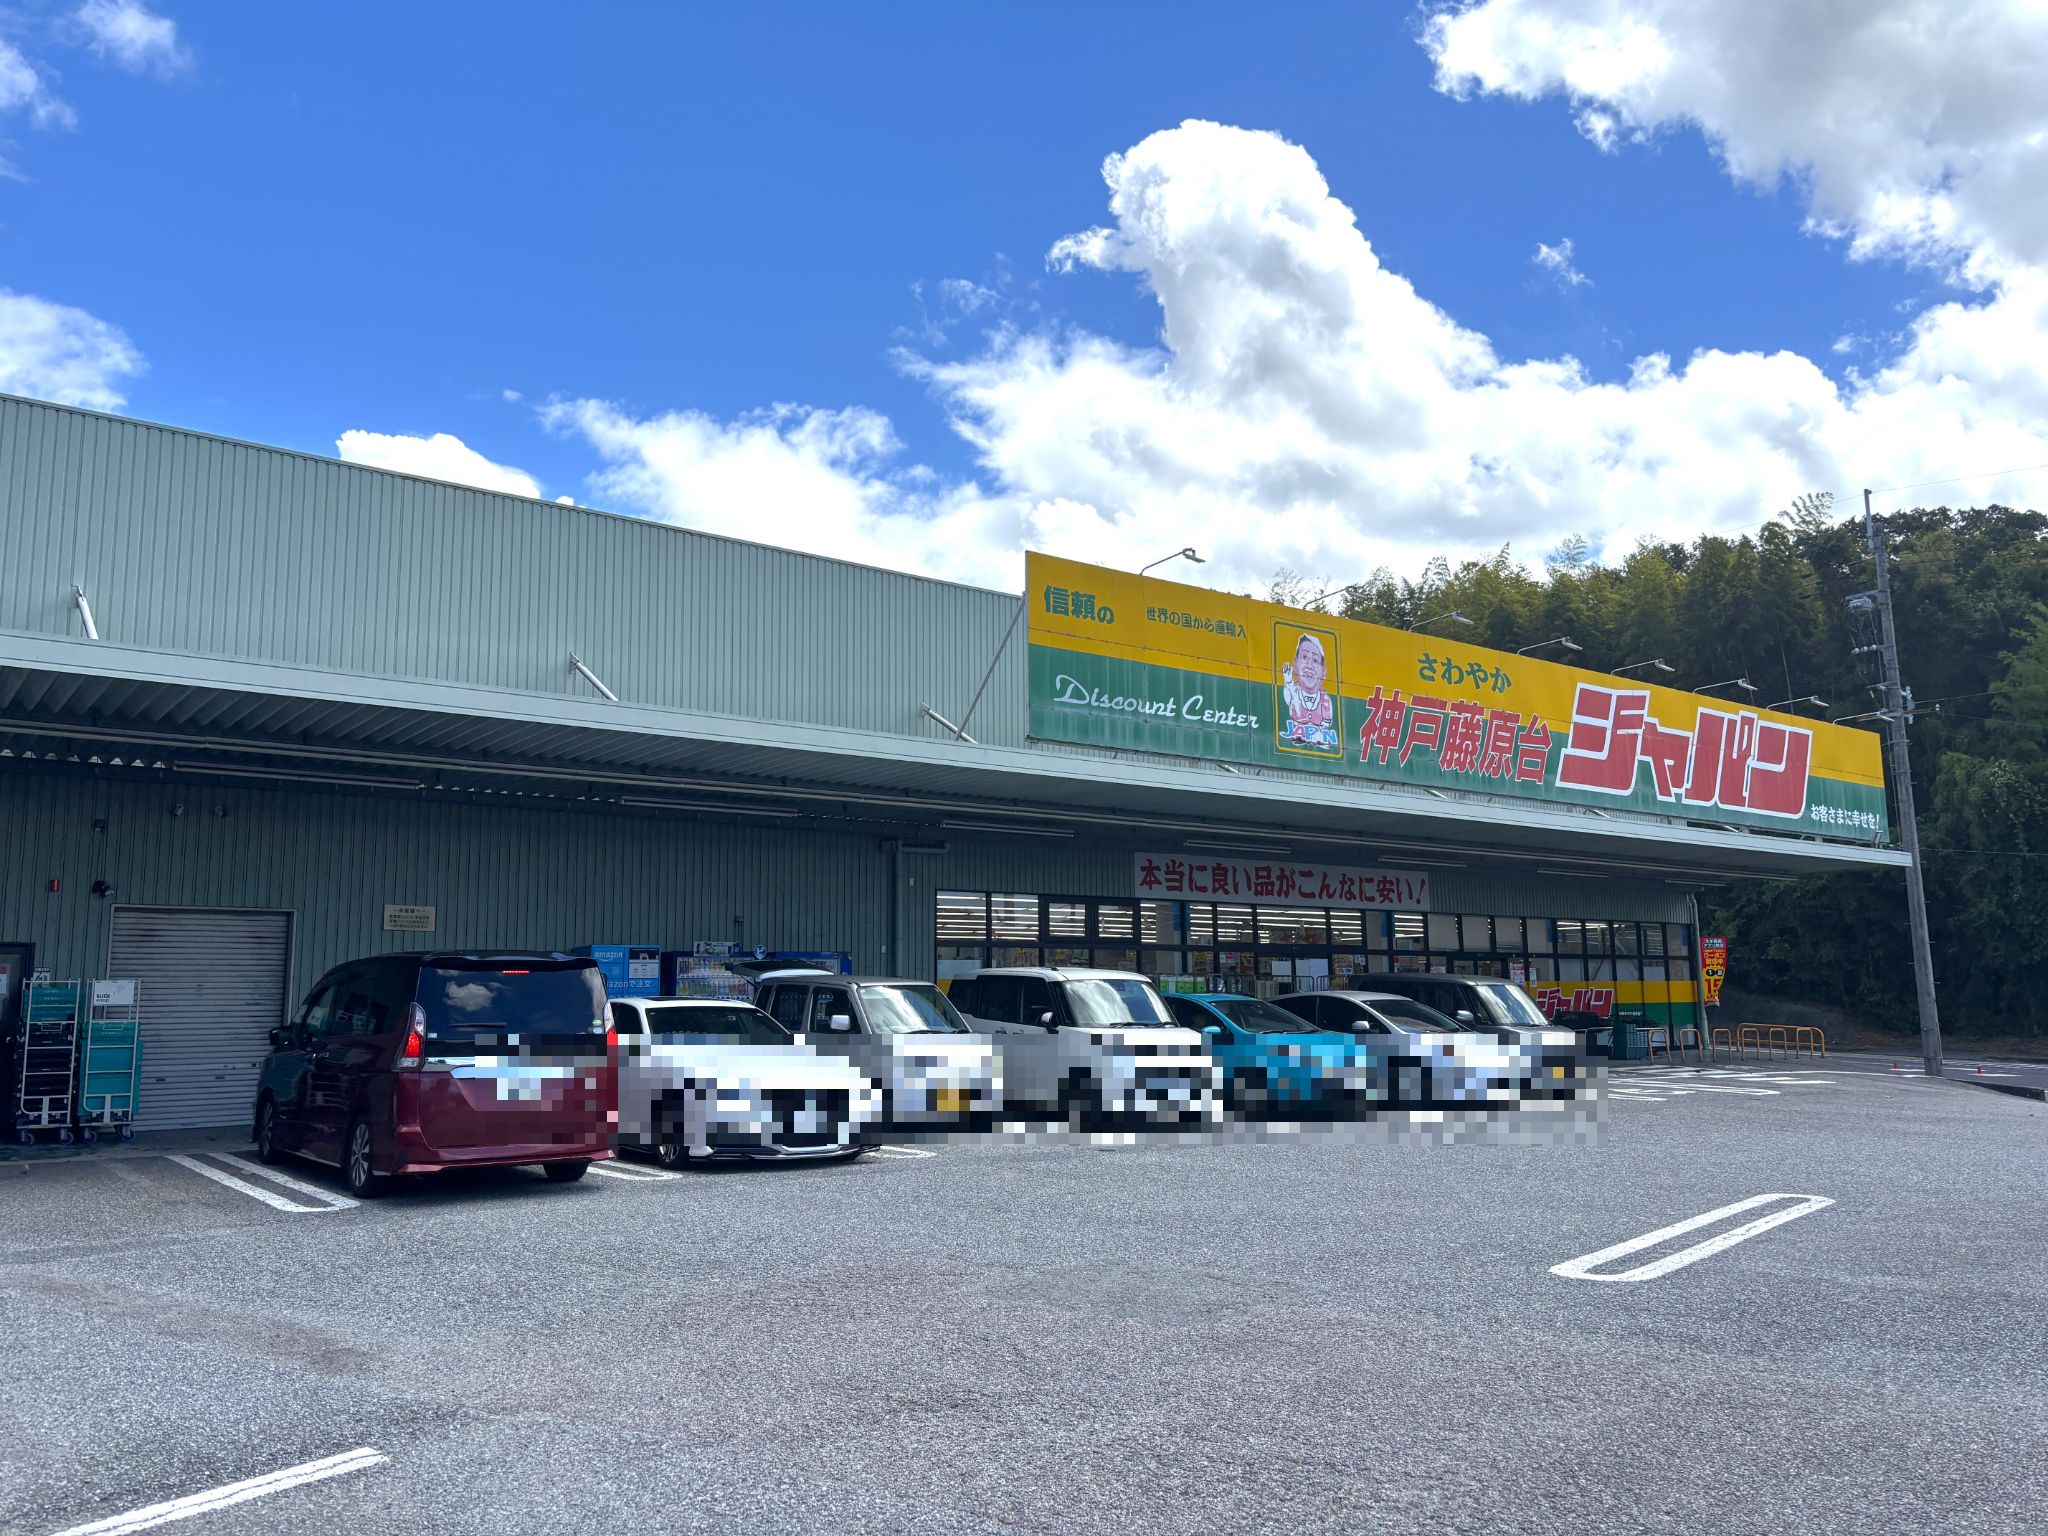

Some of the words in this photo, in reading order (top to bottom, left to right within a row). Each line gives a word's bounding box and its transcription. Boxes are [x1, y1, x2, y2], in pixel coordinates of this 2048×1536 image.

[1043, 585, 1115, 624] 信頼の
[1146, 606, 1248, 638] 世界の国から直輸入
[1417, 652, 1512, 694] さわやか
[1053, 674, 1176, 717] Discount
[1182, 695, 1259, 729] Center
[1360, 685, 1552, 784] 神戸藤原台
[1555, 682, 1813, 820] ジャパン
[1811, 803, 1880, 830] お客さまに幸せを!
[1139, 858, 1427, 905] 本当に良い品がこんなに安い!
[594, 951, 623, 959] amazon
